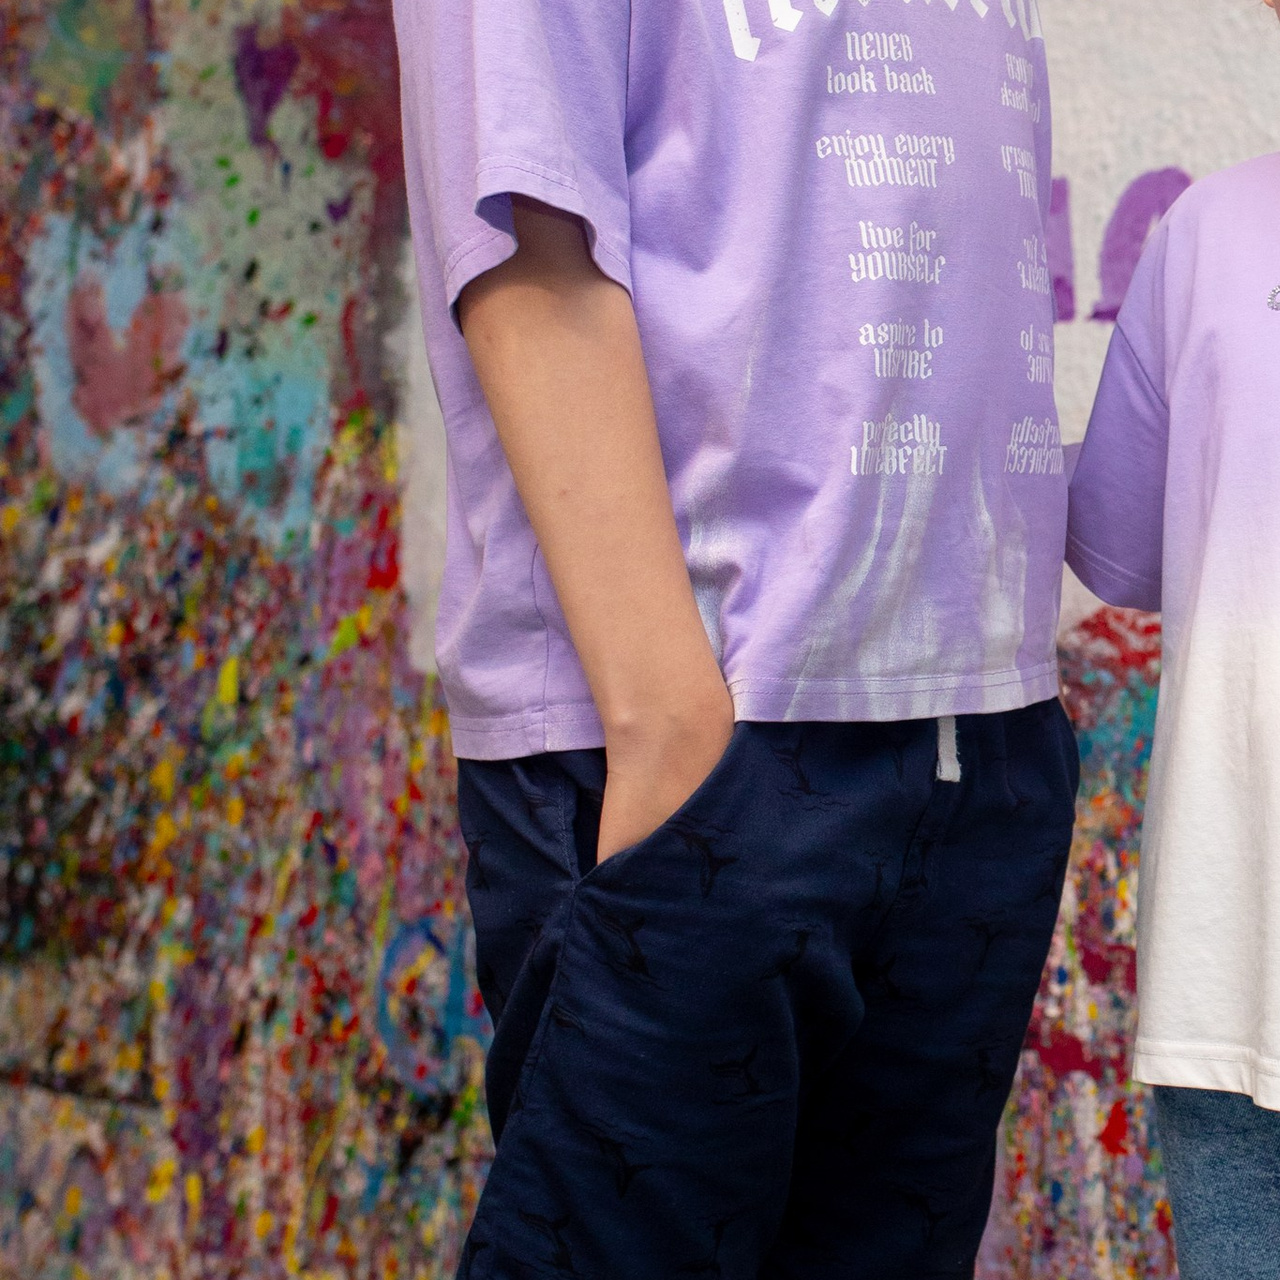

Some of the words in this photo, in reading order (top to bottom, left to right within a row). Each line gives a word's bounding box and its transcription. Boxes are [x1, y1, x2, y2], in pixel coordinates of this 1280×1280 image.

[846, 31, 913, 62] NEVER
[827, 64, 877, 94] look
[884, 64, 936, 95] back
[816, 129, 887, 162] enjoy
[894, 133, 955, 165] every
[859, 220, 904, 250] live
[910, 220, 936, 256] for
[859, 317, 916, 351] aspire
